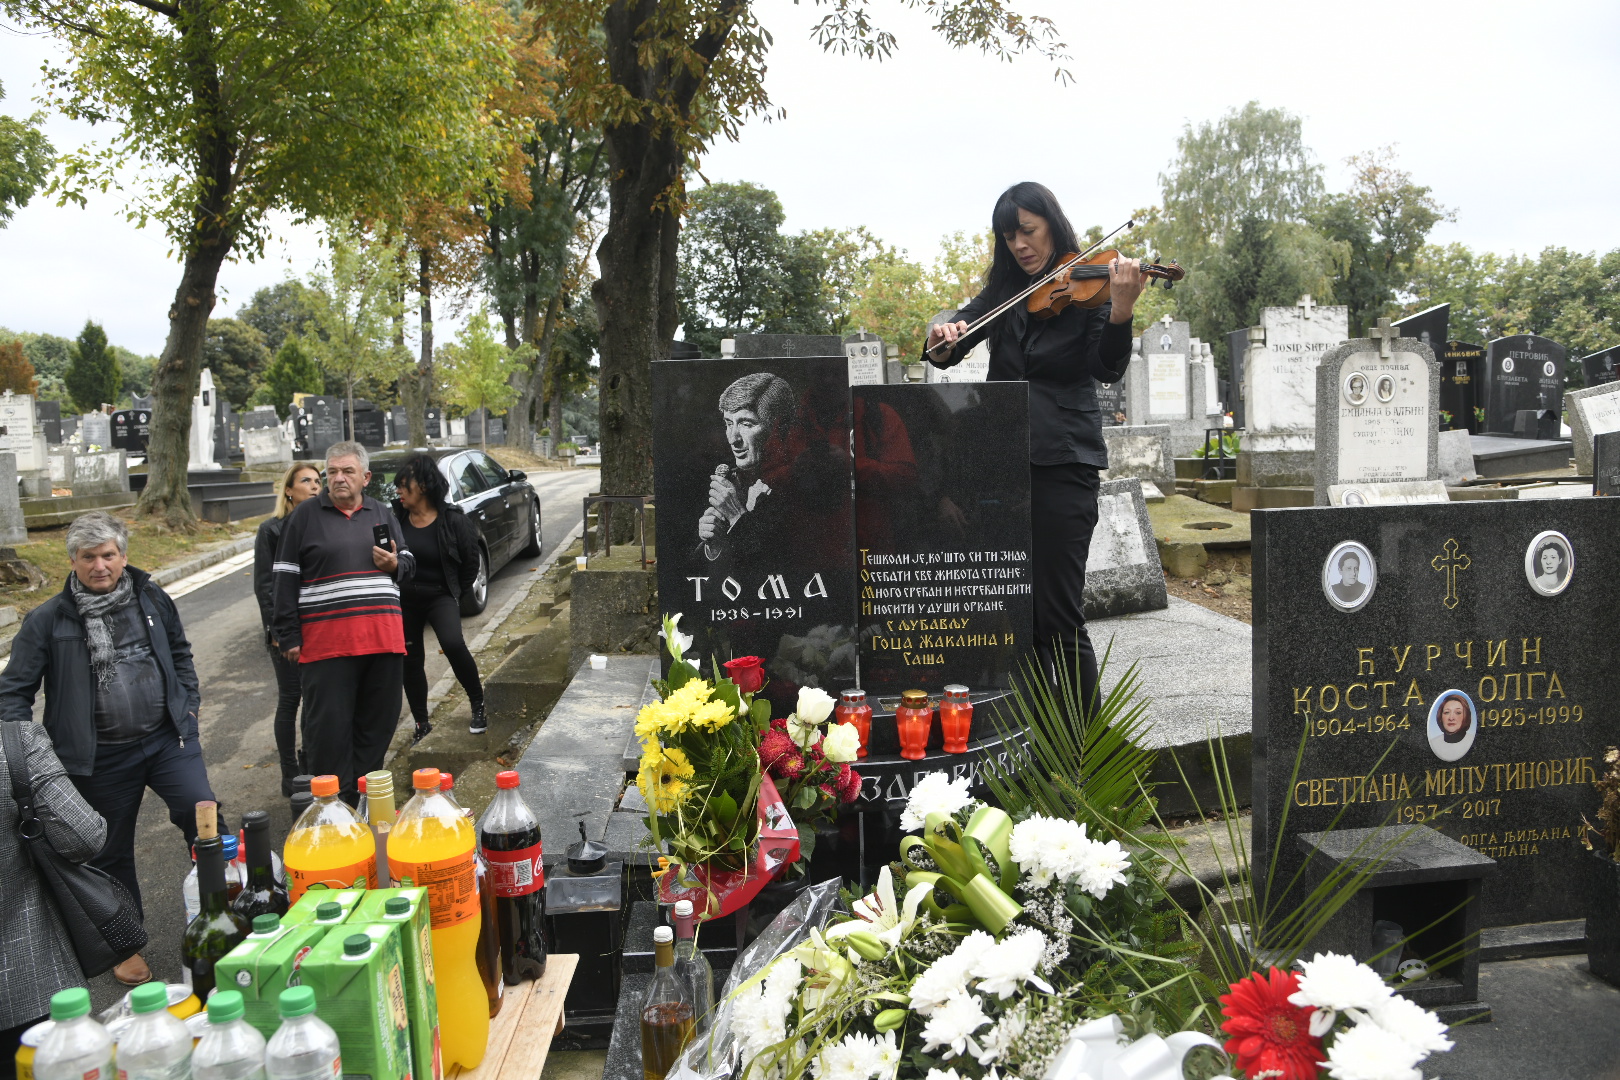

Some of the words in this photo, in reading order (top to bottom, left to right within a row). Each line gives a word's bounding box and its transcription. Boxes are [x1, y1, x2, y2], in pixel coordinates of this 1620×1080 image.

[1509, 350, 1549, 361] ПЕТРОВИЋ
[984, 551, 998, 562] ТИ
[914, 570, 932, 581] СВЕ
[934, 569, 980, 581] ЖИВОТА
[685, 572, 829, 602] ТОМА
[861, 585, 902, 599] МНОГО
[903, 586, 942, 598] СРЕЋАН
[944, 586, 952, 597] И
[1006, 583, 1032, 595] БИТИ
[862, 601, 872, 616] И
[873, 603, 916, 615] НОСИТИ
[926, 601, 960, 614] ДУШИ
[897, 617, 970, 631] ЉУБАВЉУ
[872, 634, 914, 650] ГОЦА
[919, 633, 999, 649] ЖАКЛИНА
[1003, 632, 1015, 645] И
[902, 651, 946, 666] САША
[1292, 677, 1425, 715] КОСТА
[1477, 670, 1567, 703] ОЛГА
[1310, 713, 1411, 737] 1904-1964
[1480, 704, 1584, 728] 1925-1999
[860, 741, 1032, 802] ЗДВКОВИЋ
[1294, 772, 1413, 807] СВЕТЛАНА
[1424, 756, 1597, 797] МИЛУТИНОВИЋ
[1396, 804, 1438, 824] 1957
[1462, 798, 1501, 819] 2017
[1460, 832, 1498, 846] ОЛГА
[1503, 826, 1571, 844] ЉИЉАНА
[1477, 843, 1540, 859] ЕТЛАНА
